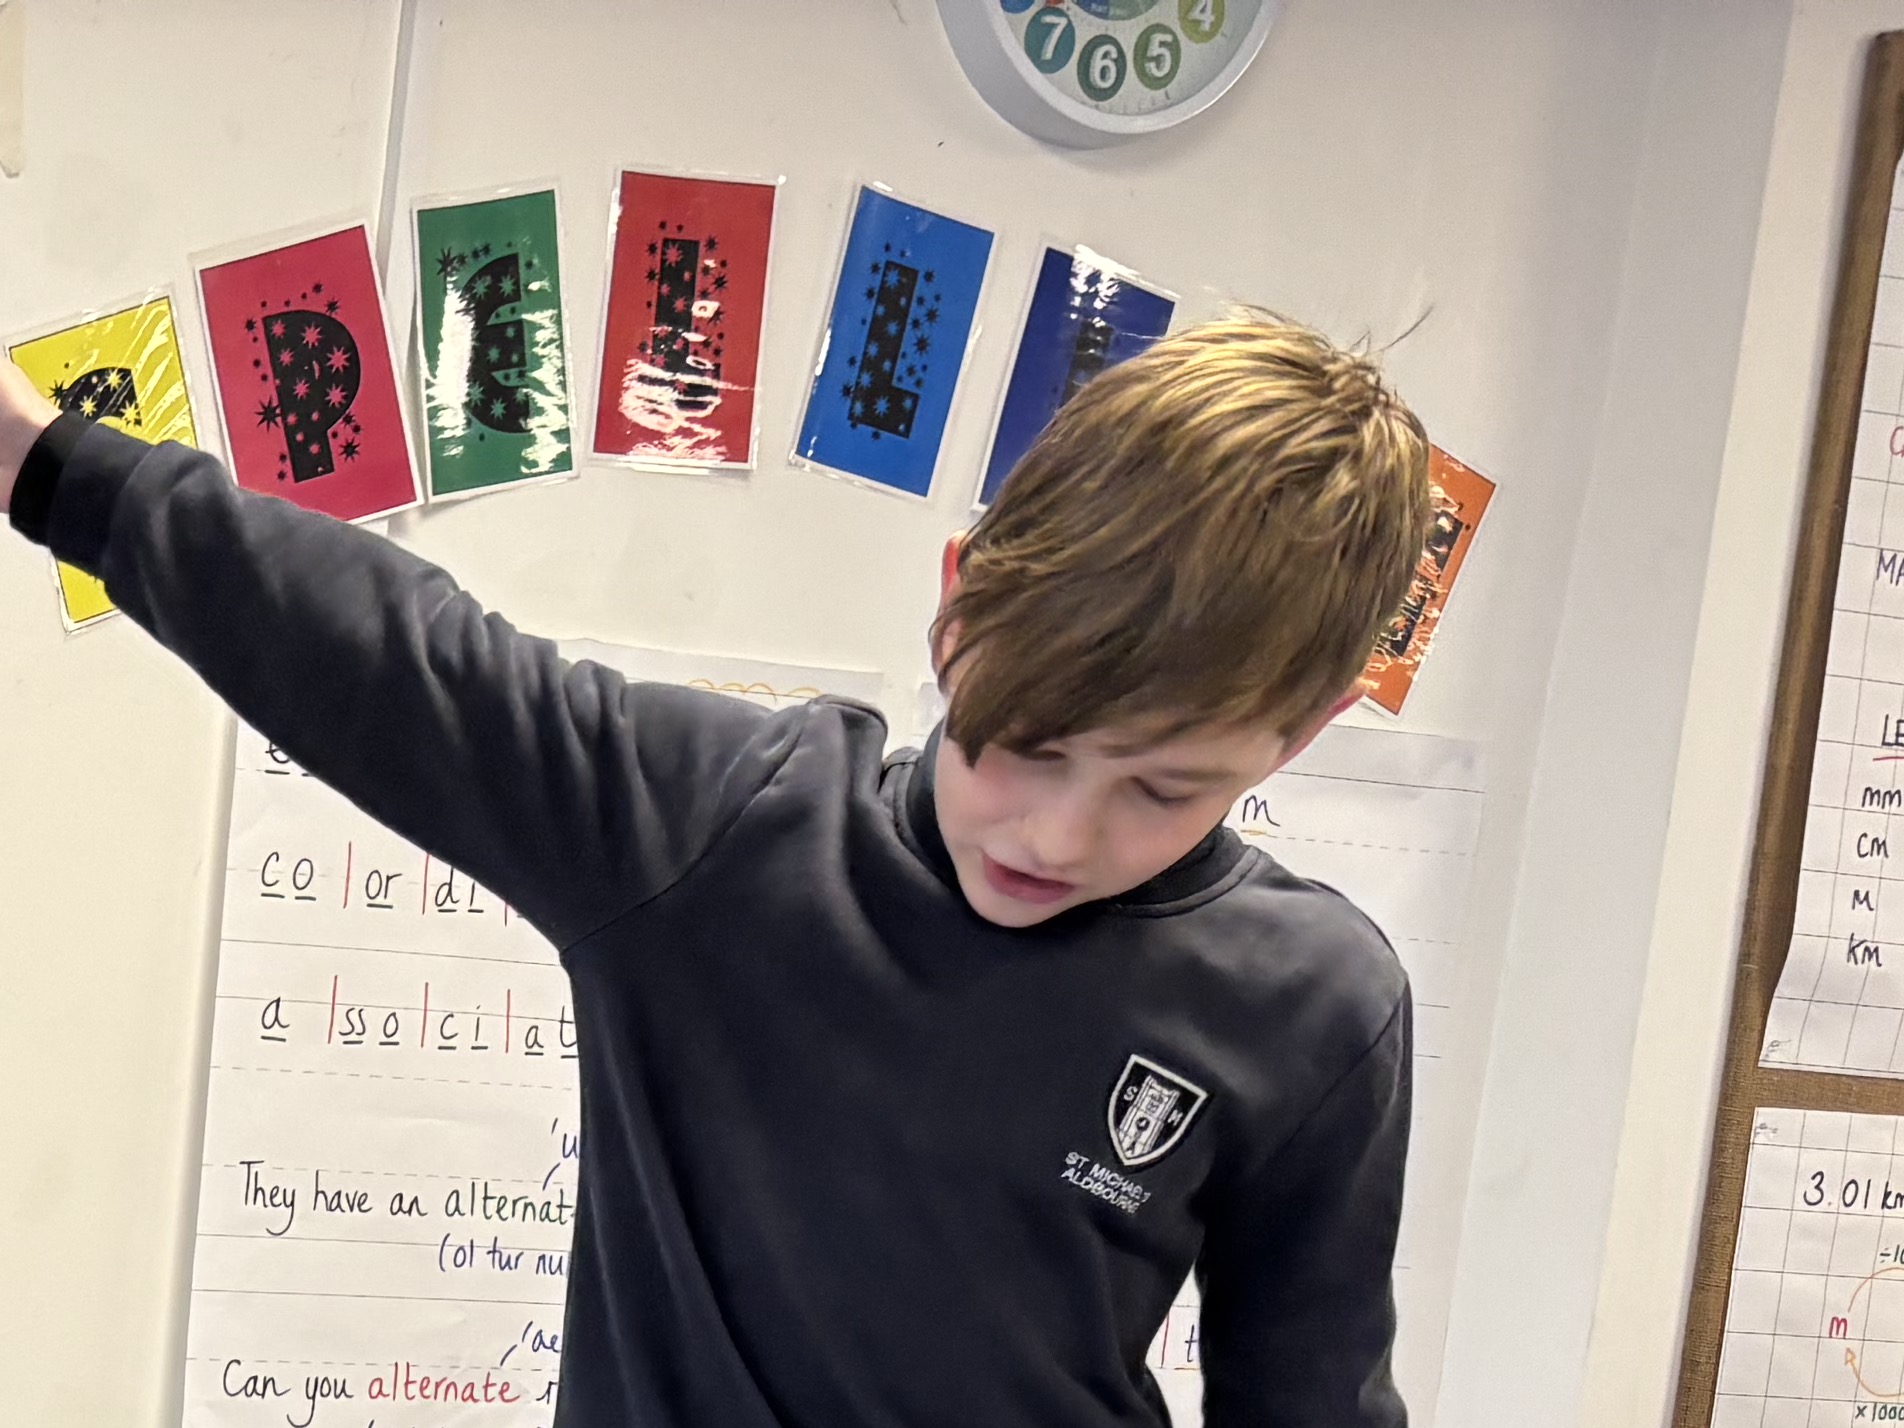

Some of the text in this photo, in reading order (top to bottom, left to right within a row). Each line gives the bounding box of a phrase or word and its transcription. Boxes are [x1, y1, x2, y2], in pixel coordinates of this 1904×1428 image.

[1039, 16, 1068, 61] 7
[1146, 33, 1173, 79] 5
[1092, 44, 1118, 89] 6
[238, 1158, 429, 1239] They have an
[221, 1357, 292, 1401] Can
[366, 1360, 522, 1405] alternate
